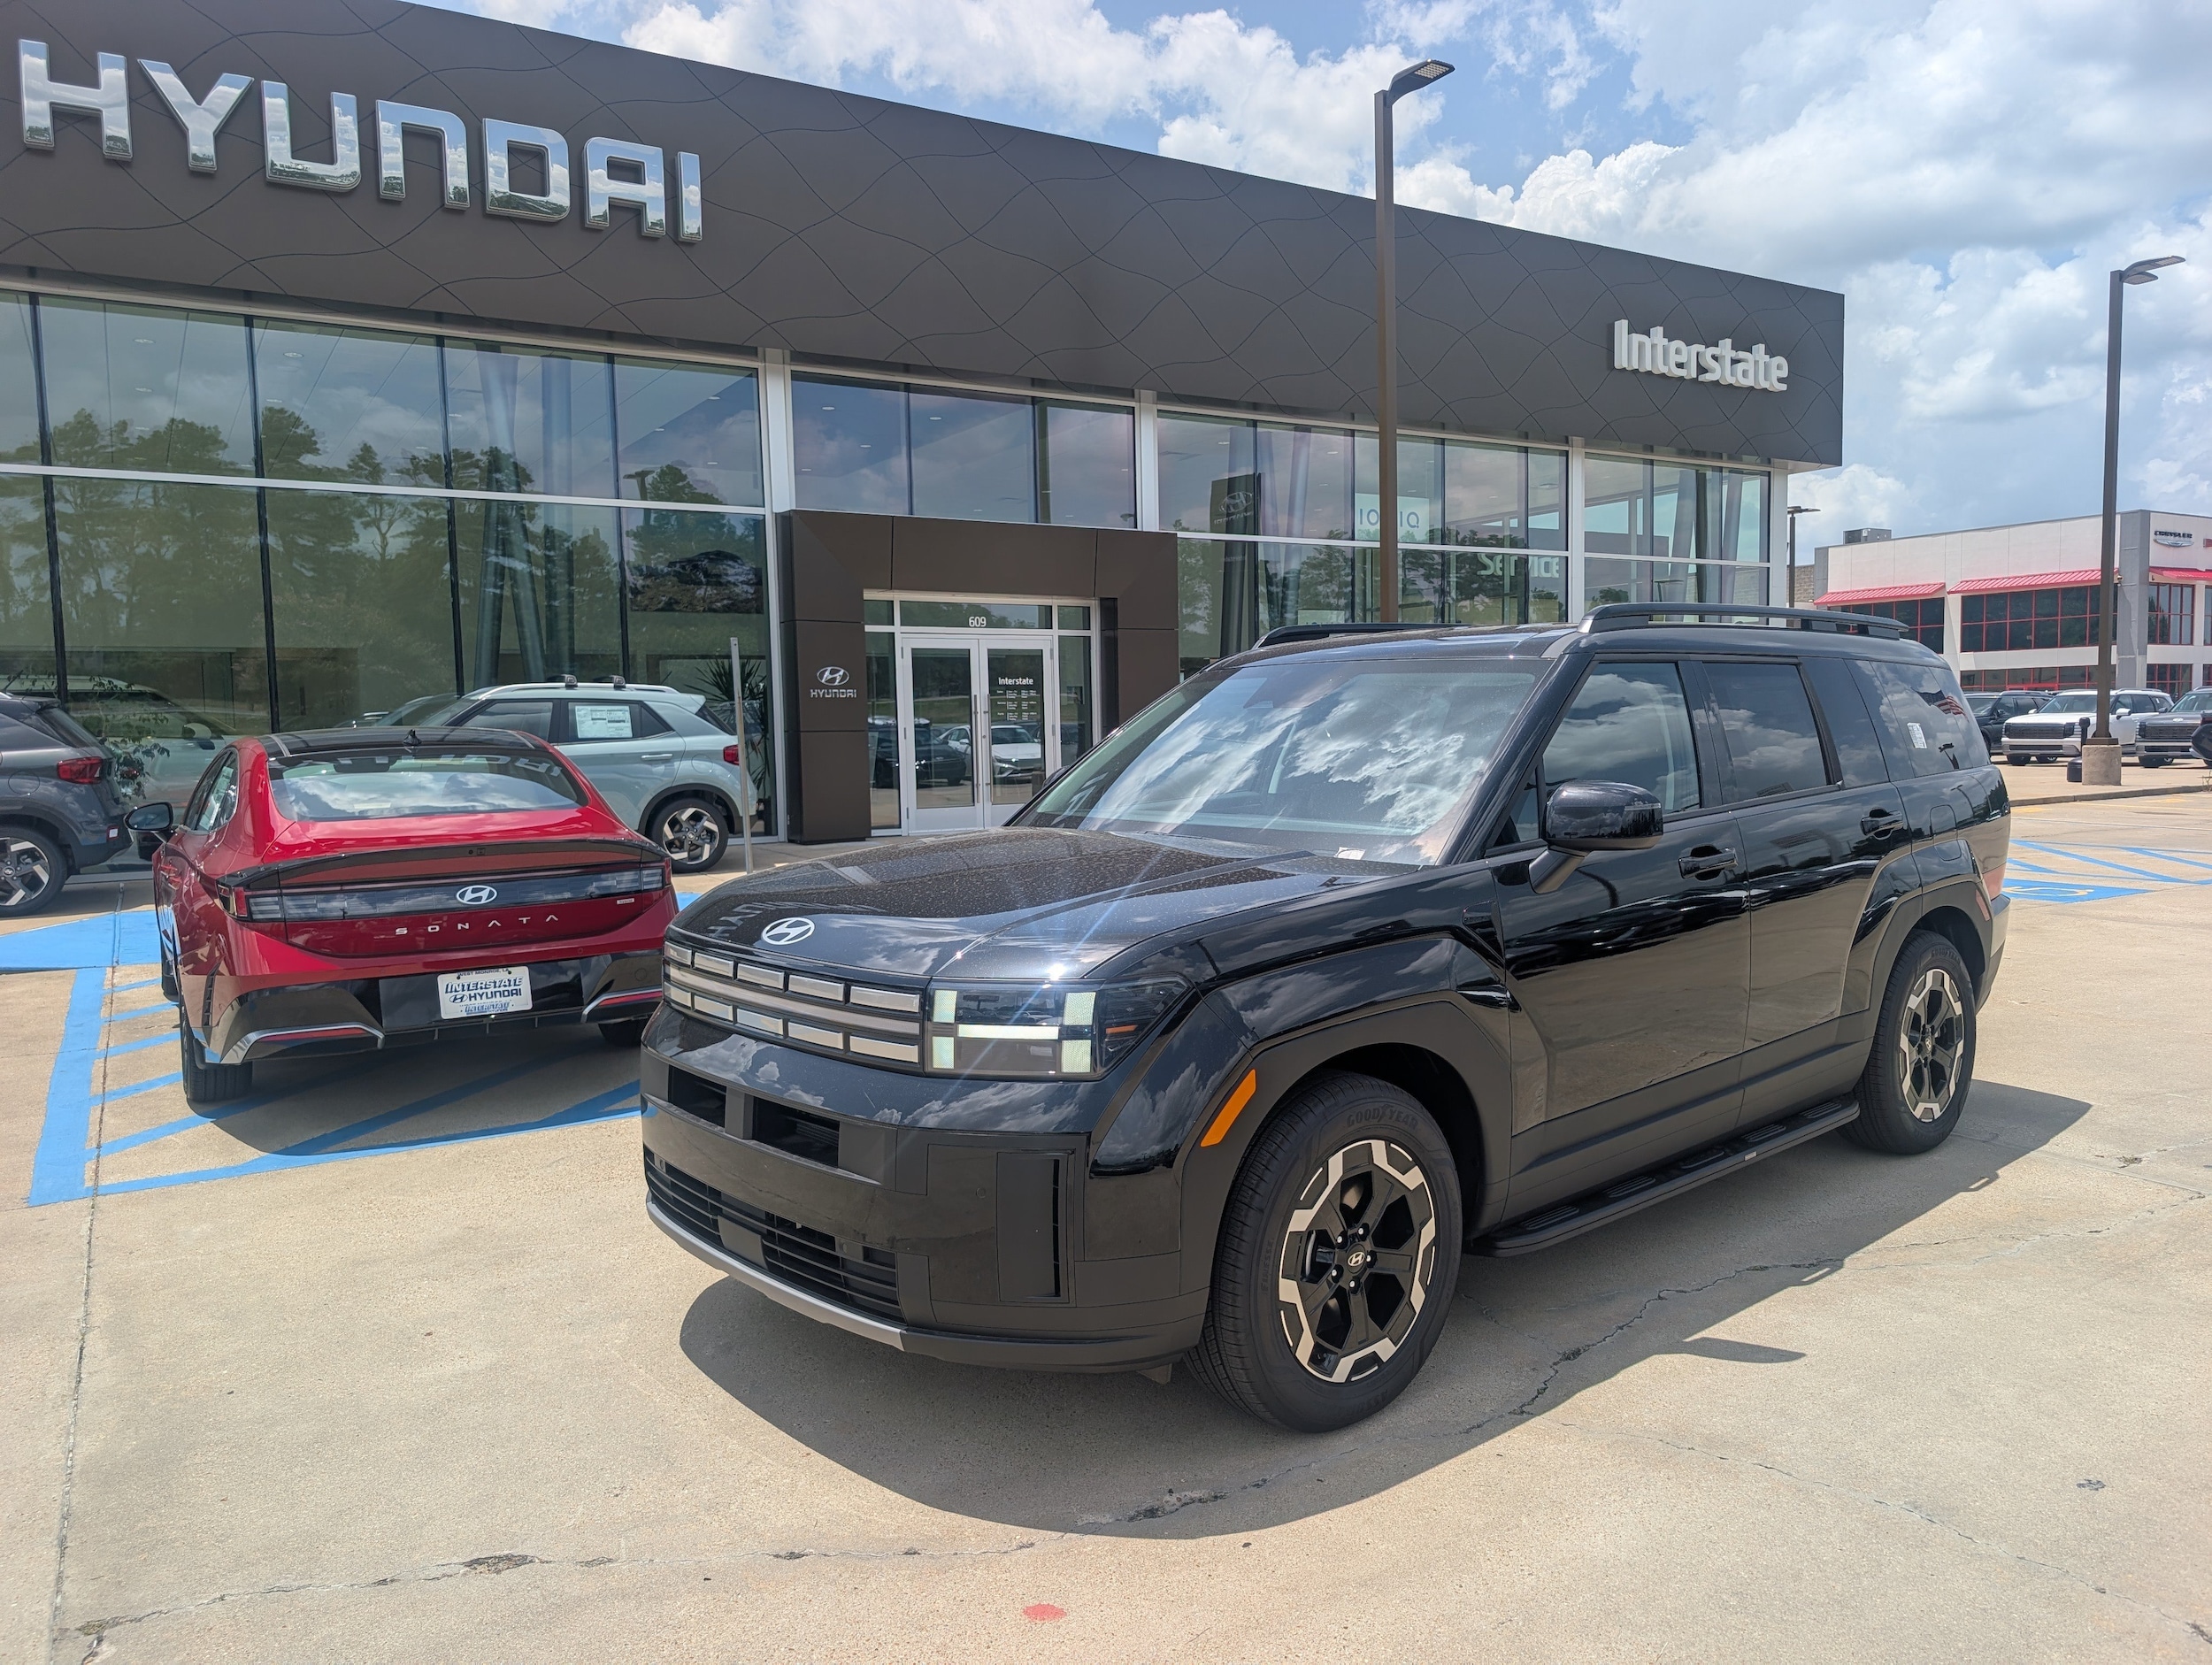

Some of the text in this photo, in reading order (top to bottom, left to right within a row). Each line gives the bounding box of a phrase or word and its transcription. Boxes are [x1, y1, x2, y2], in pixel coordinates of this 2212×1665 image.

[18, 39, 703, 242] HYUNDAI
[1614, 318, 1789, 392] Interstate
[1359, 508, 1420, 528] IOIQ
[969, 617, 987, 627] 609
[810, 688, 857, 698] HYUNDAI
[396, 914, 559, 936] SONATA
[445, 977, 524, 994] INTERSTATE
[469, 988, 522, 1001] HYUNDAI
